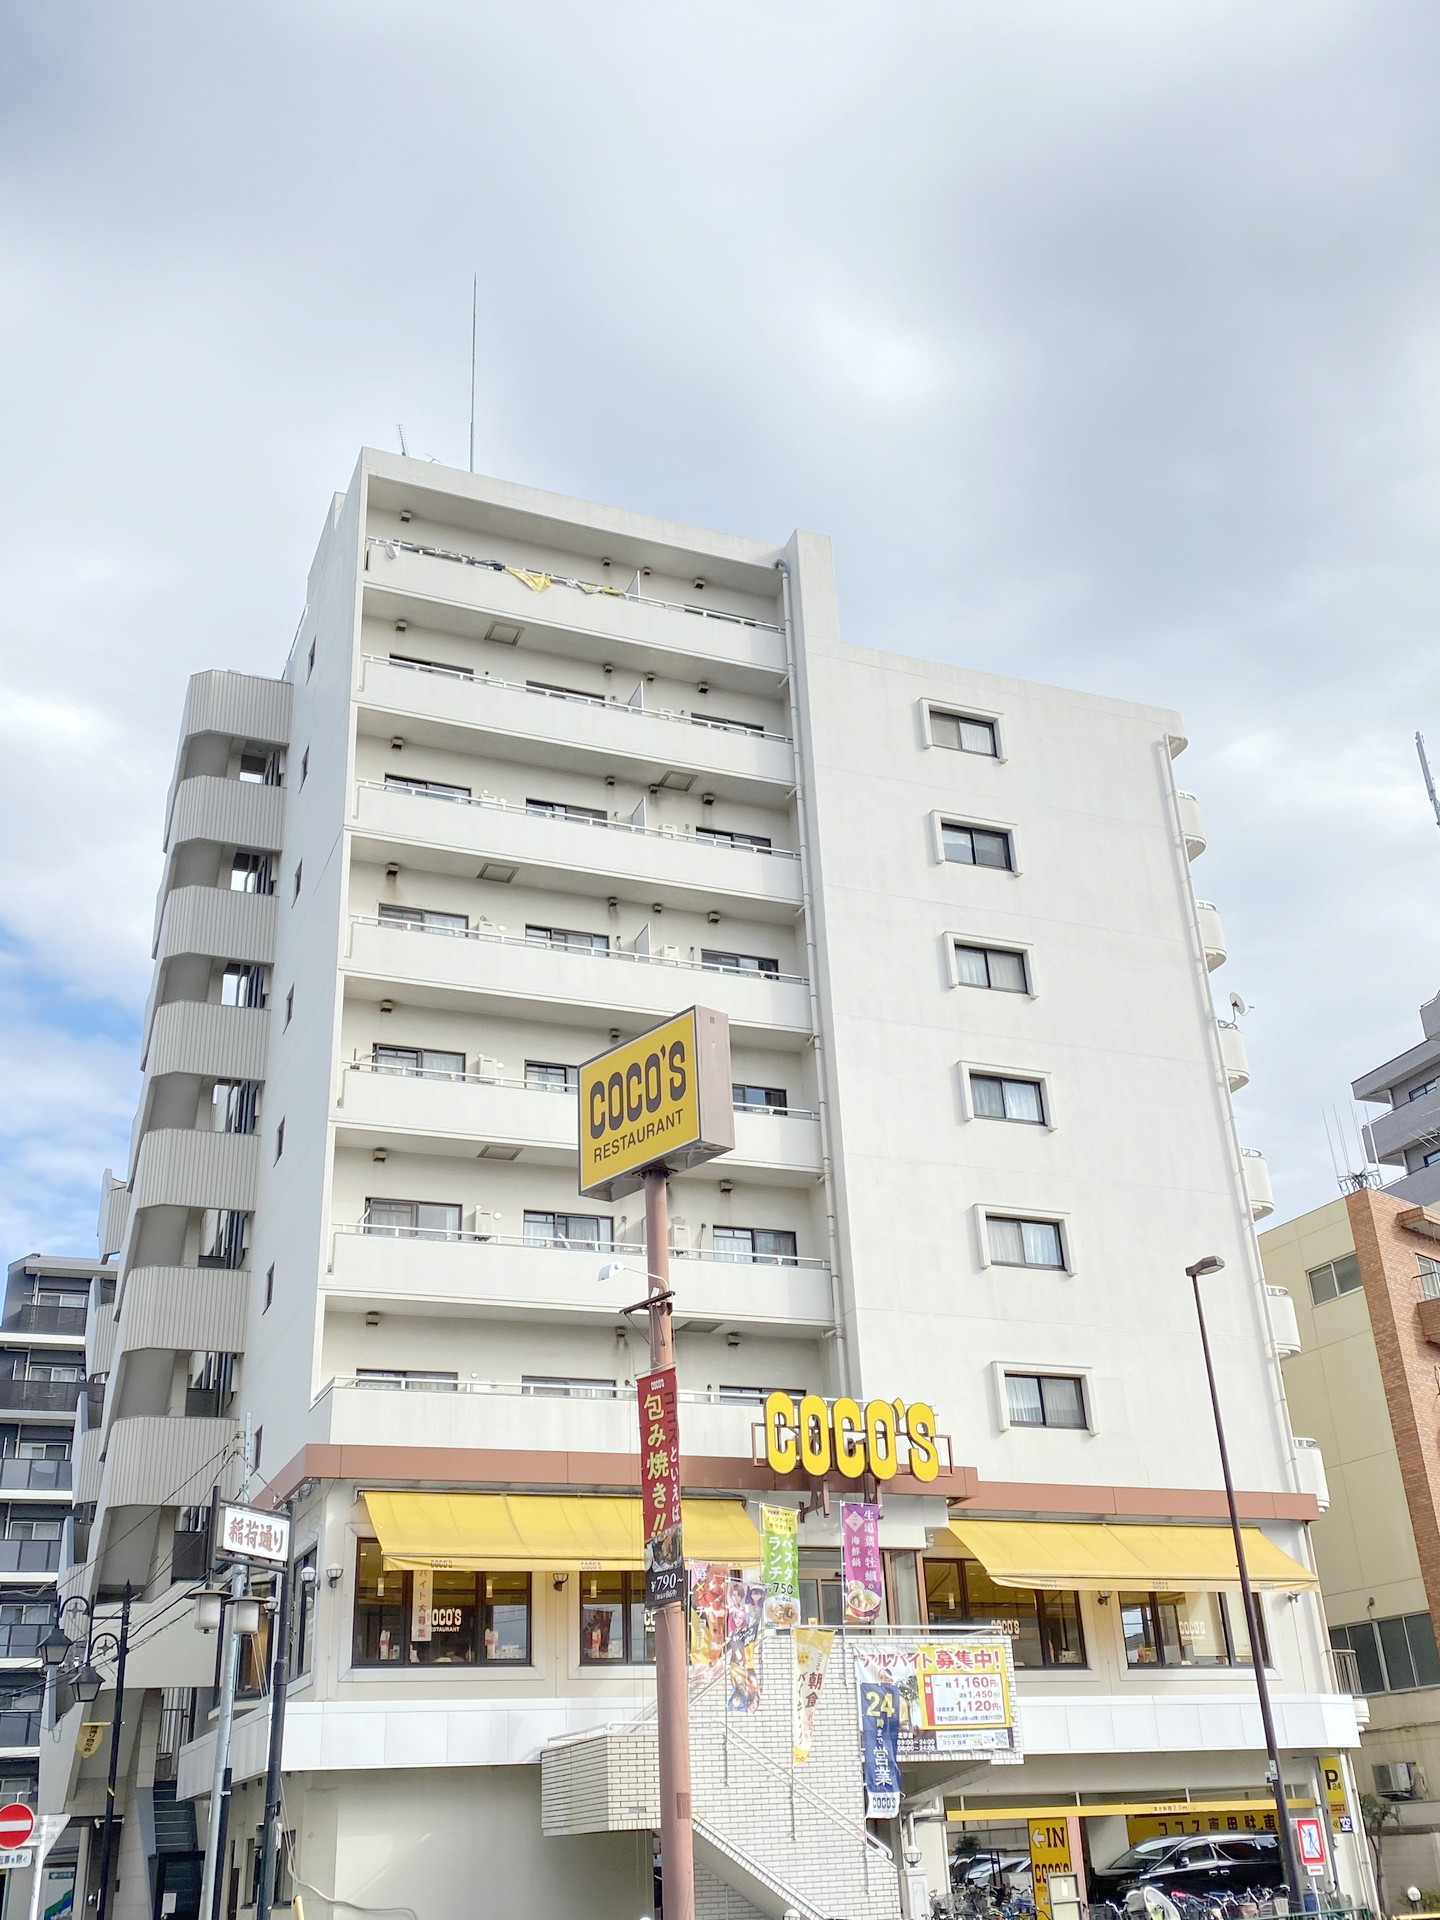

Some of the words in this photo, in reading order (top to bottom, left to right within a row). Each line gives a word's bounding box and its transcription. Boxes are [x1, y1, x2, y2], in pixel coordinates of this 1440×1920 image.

[590, 1040, 686, 1139] COCO'S
[594, 1108, 684, 1163] RESTAURANT
[765, 1391, 939, 1482] COCO'S
[228, 1517, 284, 1553] 稲荷通り
[768, 1536, 783, 1580] ランチ
[782, 1538, 794, 1581] パスタ
[1179, 1621, 1205, 1635] COCO'S
[805, 1671, 823, 1709] 朝食
[1325, 1769, 1339, 1790] P
[1332, 1782, 1342, 1791] 24
[872, 1797, 896, 1809] COCO'S
[1046, 1826, 1066, 1849] IN
